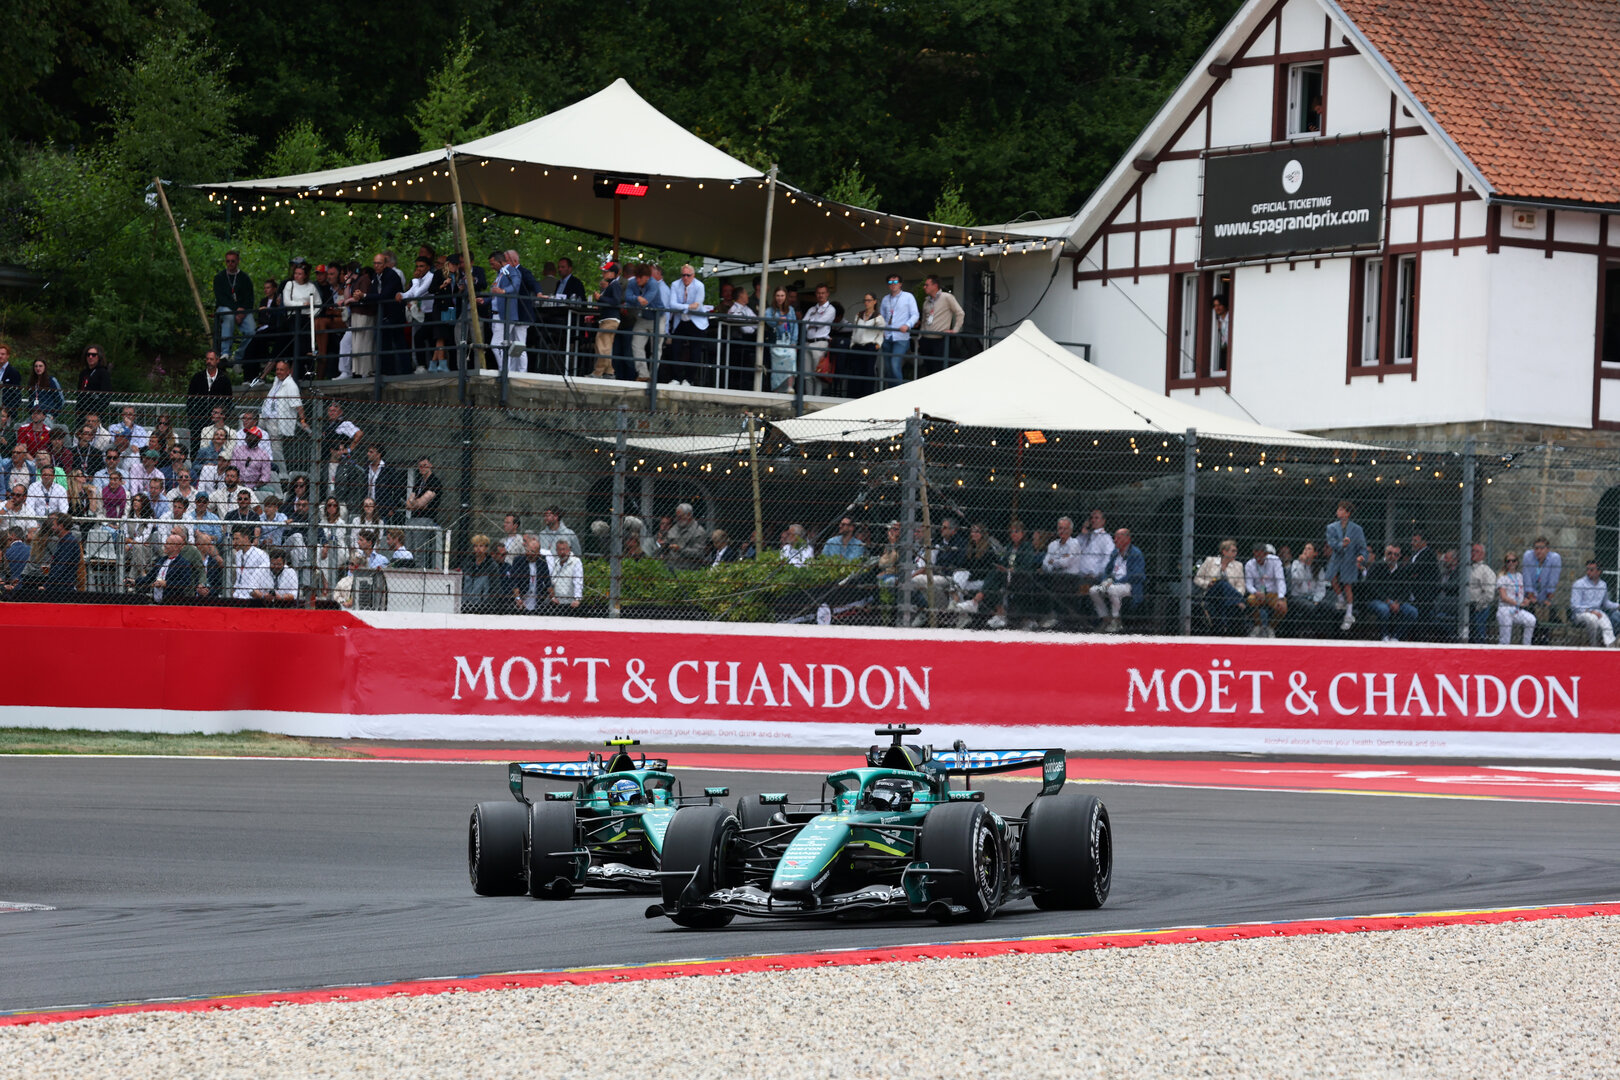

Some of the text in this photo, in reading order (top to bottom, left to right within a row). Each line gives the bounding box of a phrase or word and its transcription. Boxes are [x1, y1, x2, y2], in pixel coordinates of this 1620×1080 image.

[1251, 196, 1332, 215] OFFICIAL TICKETING
[1214, 208, 1370, 238] www.spagrandprix.com
[451, 645, 932, 710] MOËT & CHANDON
[1125, 659, 1581, 719] MOËT & CHANDON
[765, 794, 783, 802] BOSS
